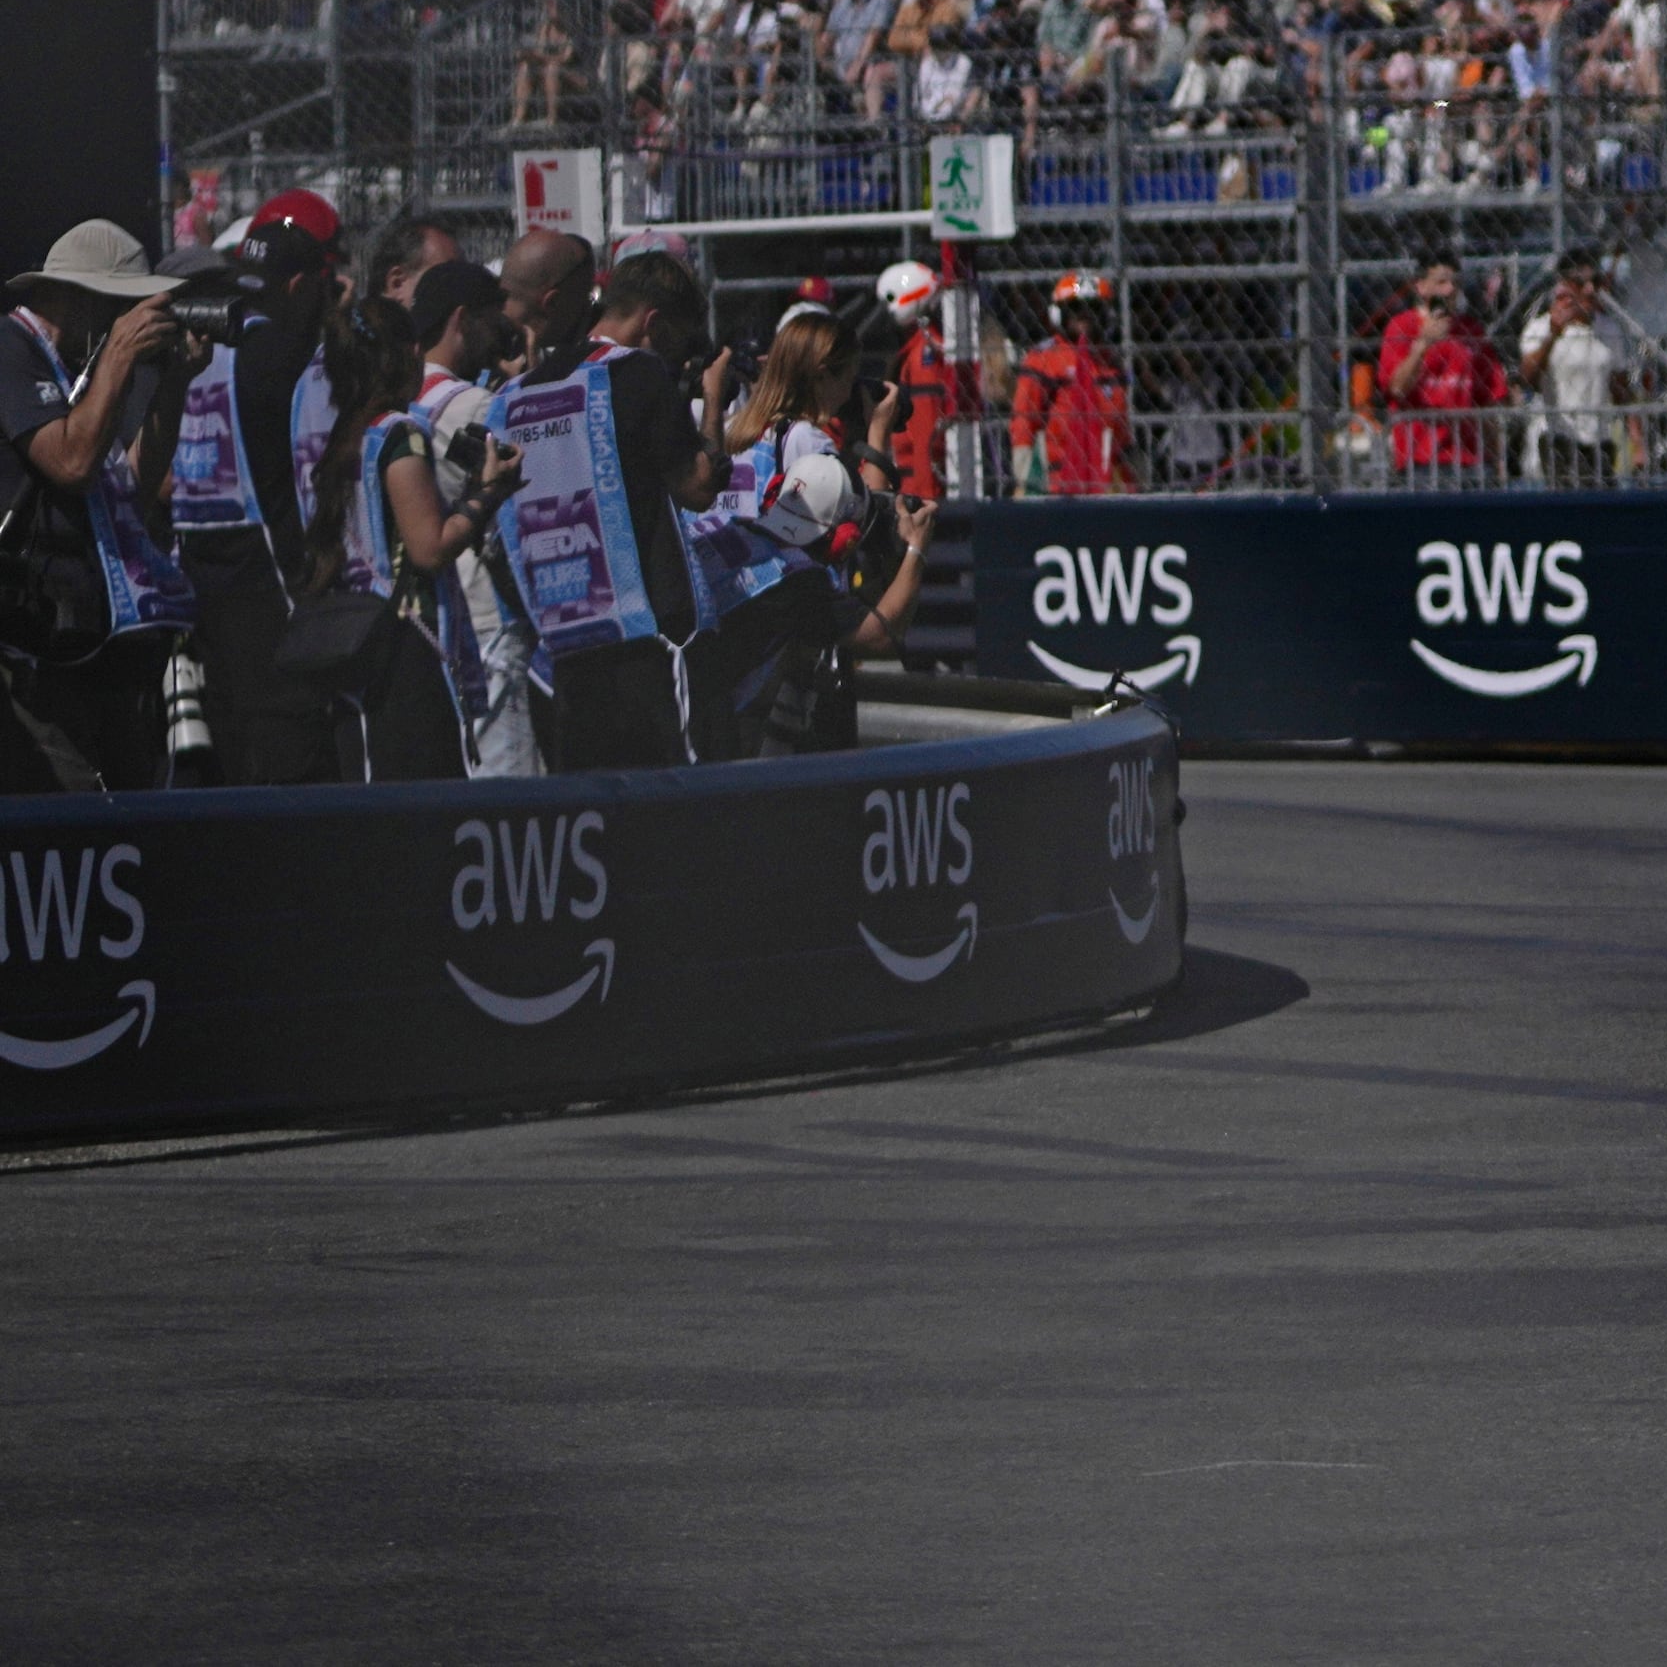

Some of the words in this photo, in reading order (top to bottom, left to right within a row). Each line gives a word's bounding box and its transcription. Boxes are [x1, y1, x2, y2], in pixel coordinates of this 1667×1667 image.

[1034, 544, 1192, 625] aws
[1417, 540, 1588, 624] aws
[863, 782, 972, 893] aws
[1108, 757, 1156, 860] aws
[0, 845, 144, 962] ws
[452, 811, 607, 929] aws
